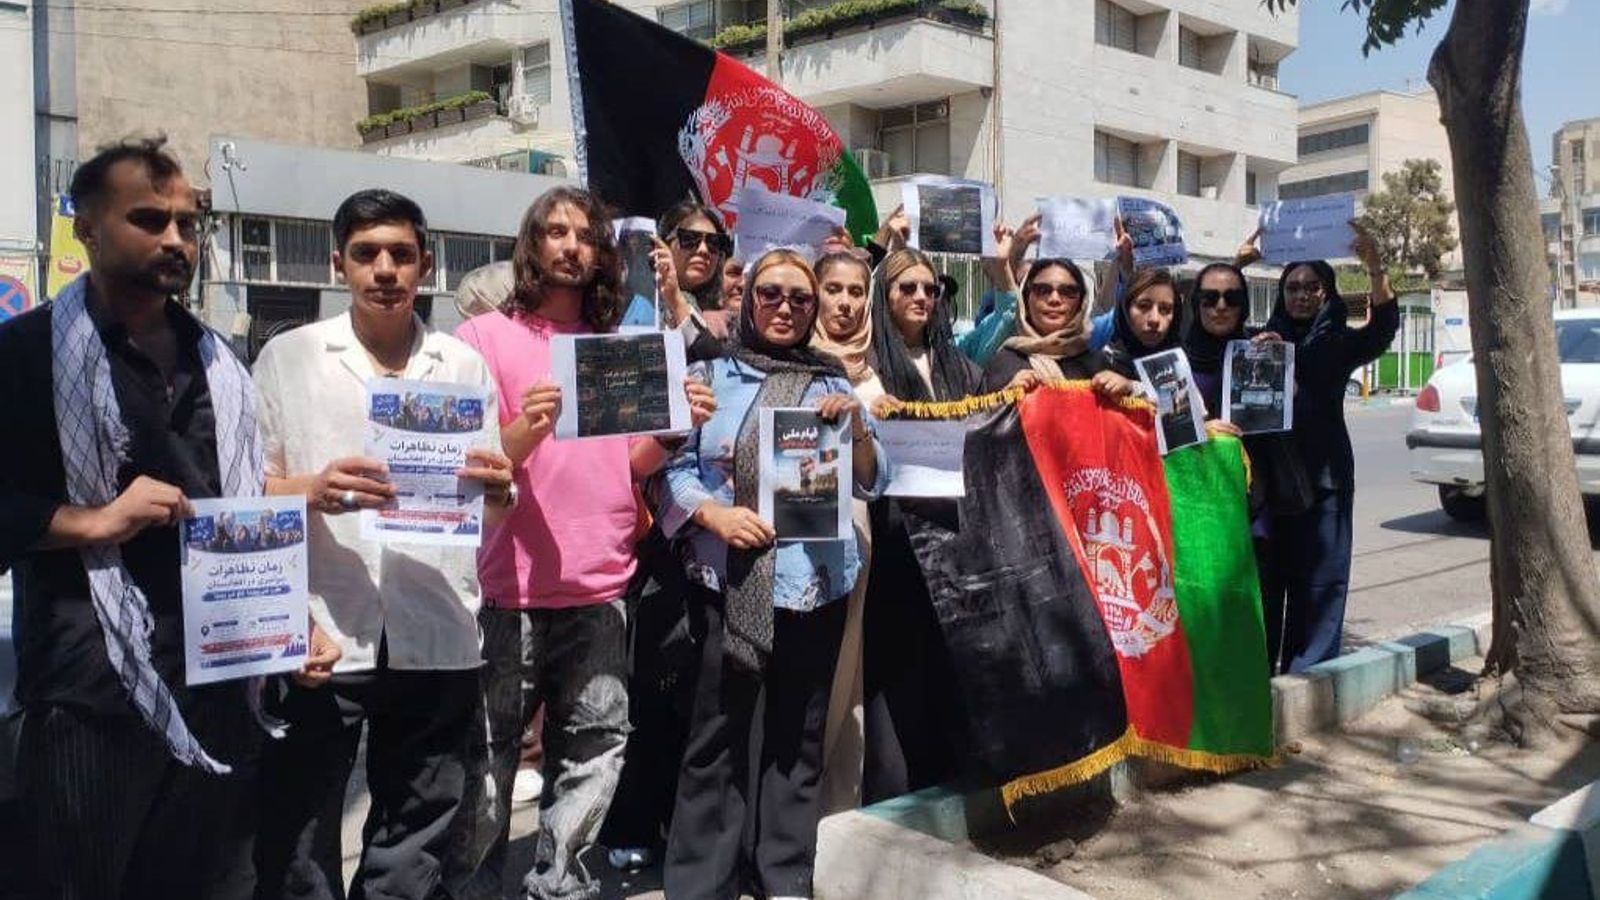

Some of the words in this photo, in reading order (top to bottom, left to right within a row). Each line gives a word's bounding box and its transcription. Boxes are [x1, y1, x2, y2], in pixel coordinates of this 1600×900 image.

[783, 428, 799, 441] ملی
[389, 439, 436, 454] تظاهرات
[439, 442, 462, 456] زمان
[208, 562, 256, 579] تظاهرات
[258, 560, 284, 576] زمان
